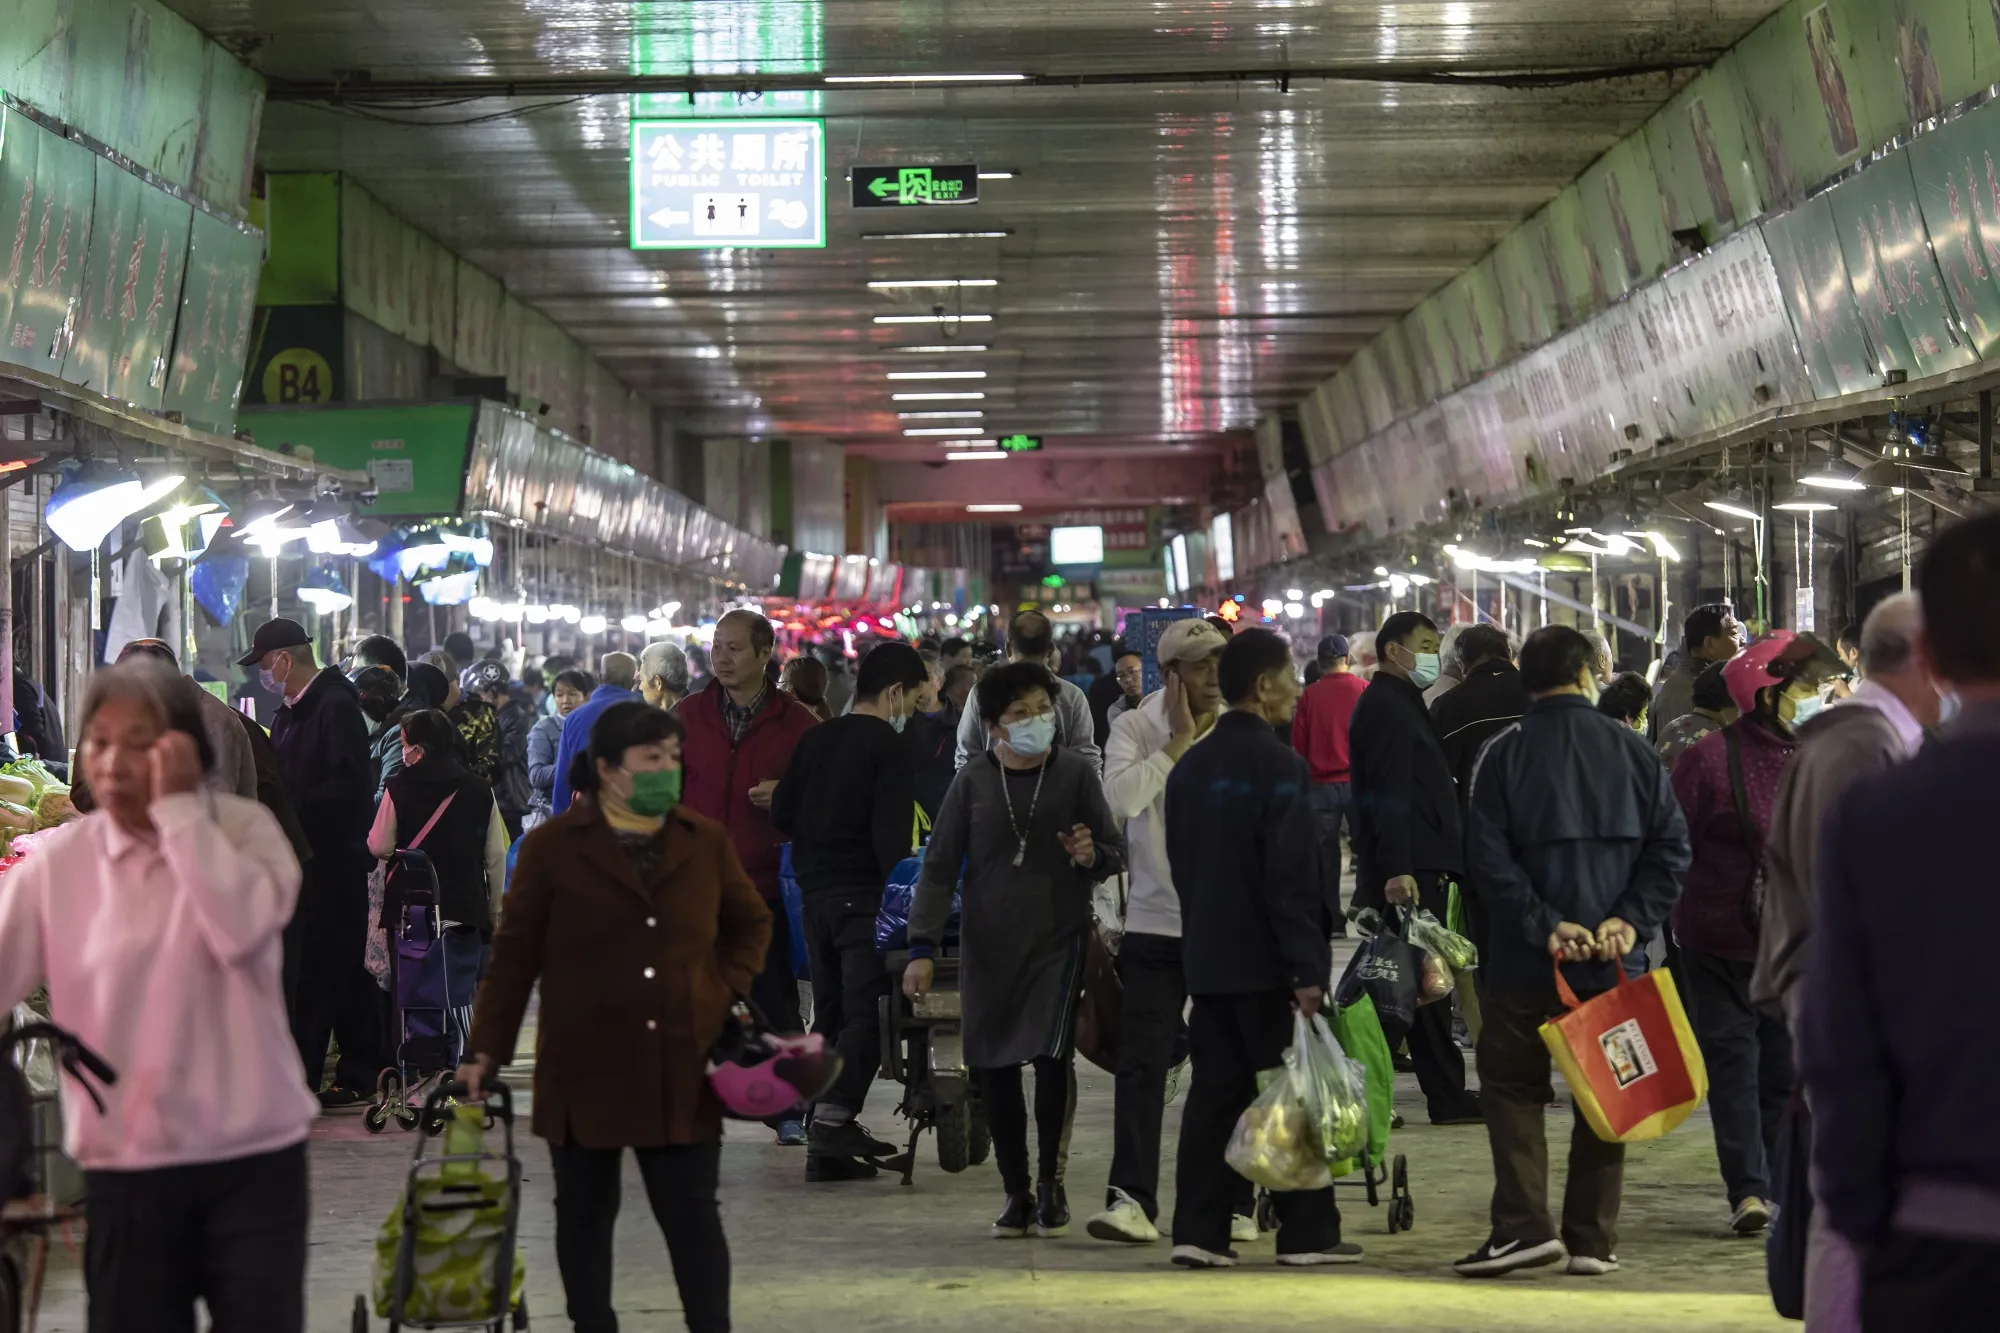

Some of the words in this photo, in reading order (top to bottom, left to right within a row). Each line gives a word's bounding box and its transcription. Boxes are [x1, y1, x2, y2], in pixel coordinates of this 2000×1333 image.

[648, 133, 809, 171] 公共厕所
[652, 173, 720, 187] PUBLIC
[736, 173, 804, 187] TOILET
[932, 180, 963, 191] 安全出口
[935, 191, 959, 200] EXIT
[280, 363, 322, 401] B4
